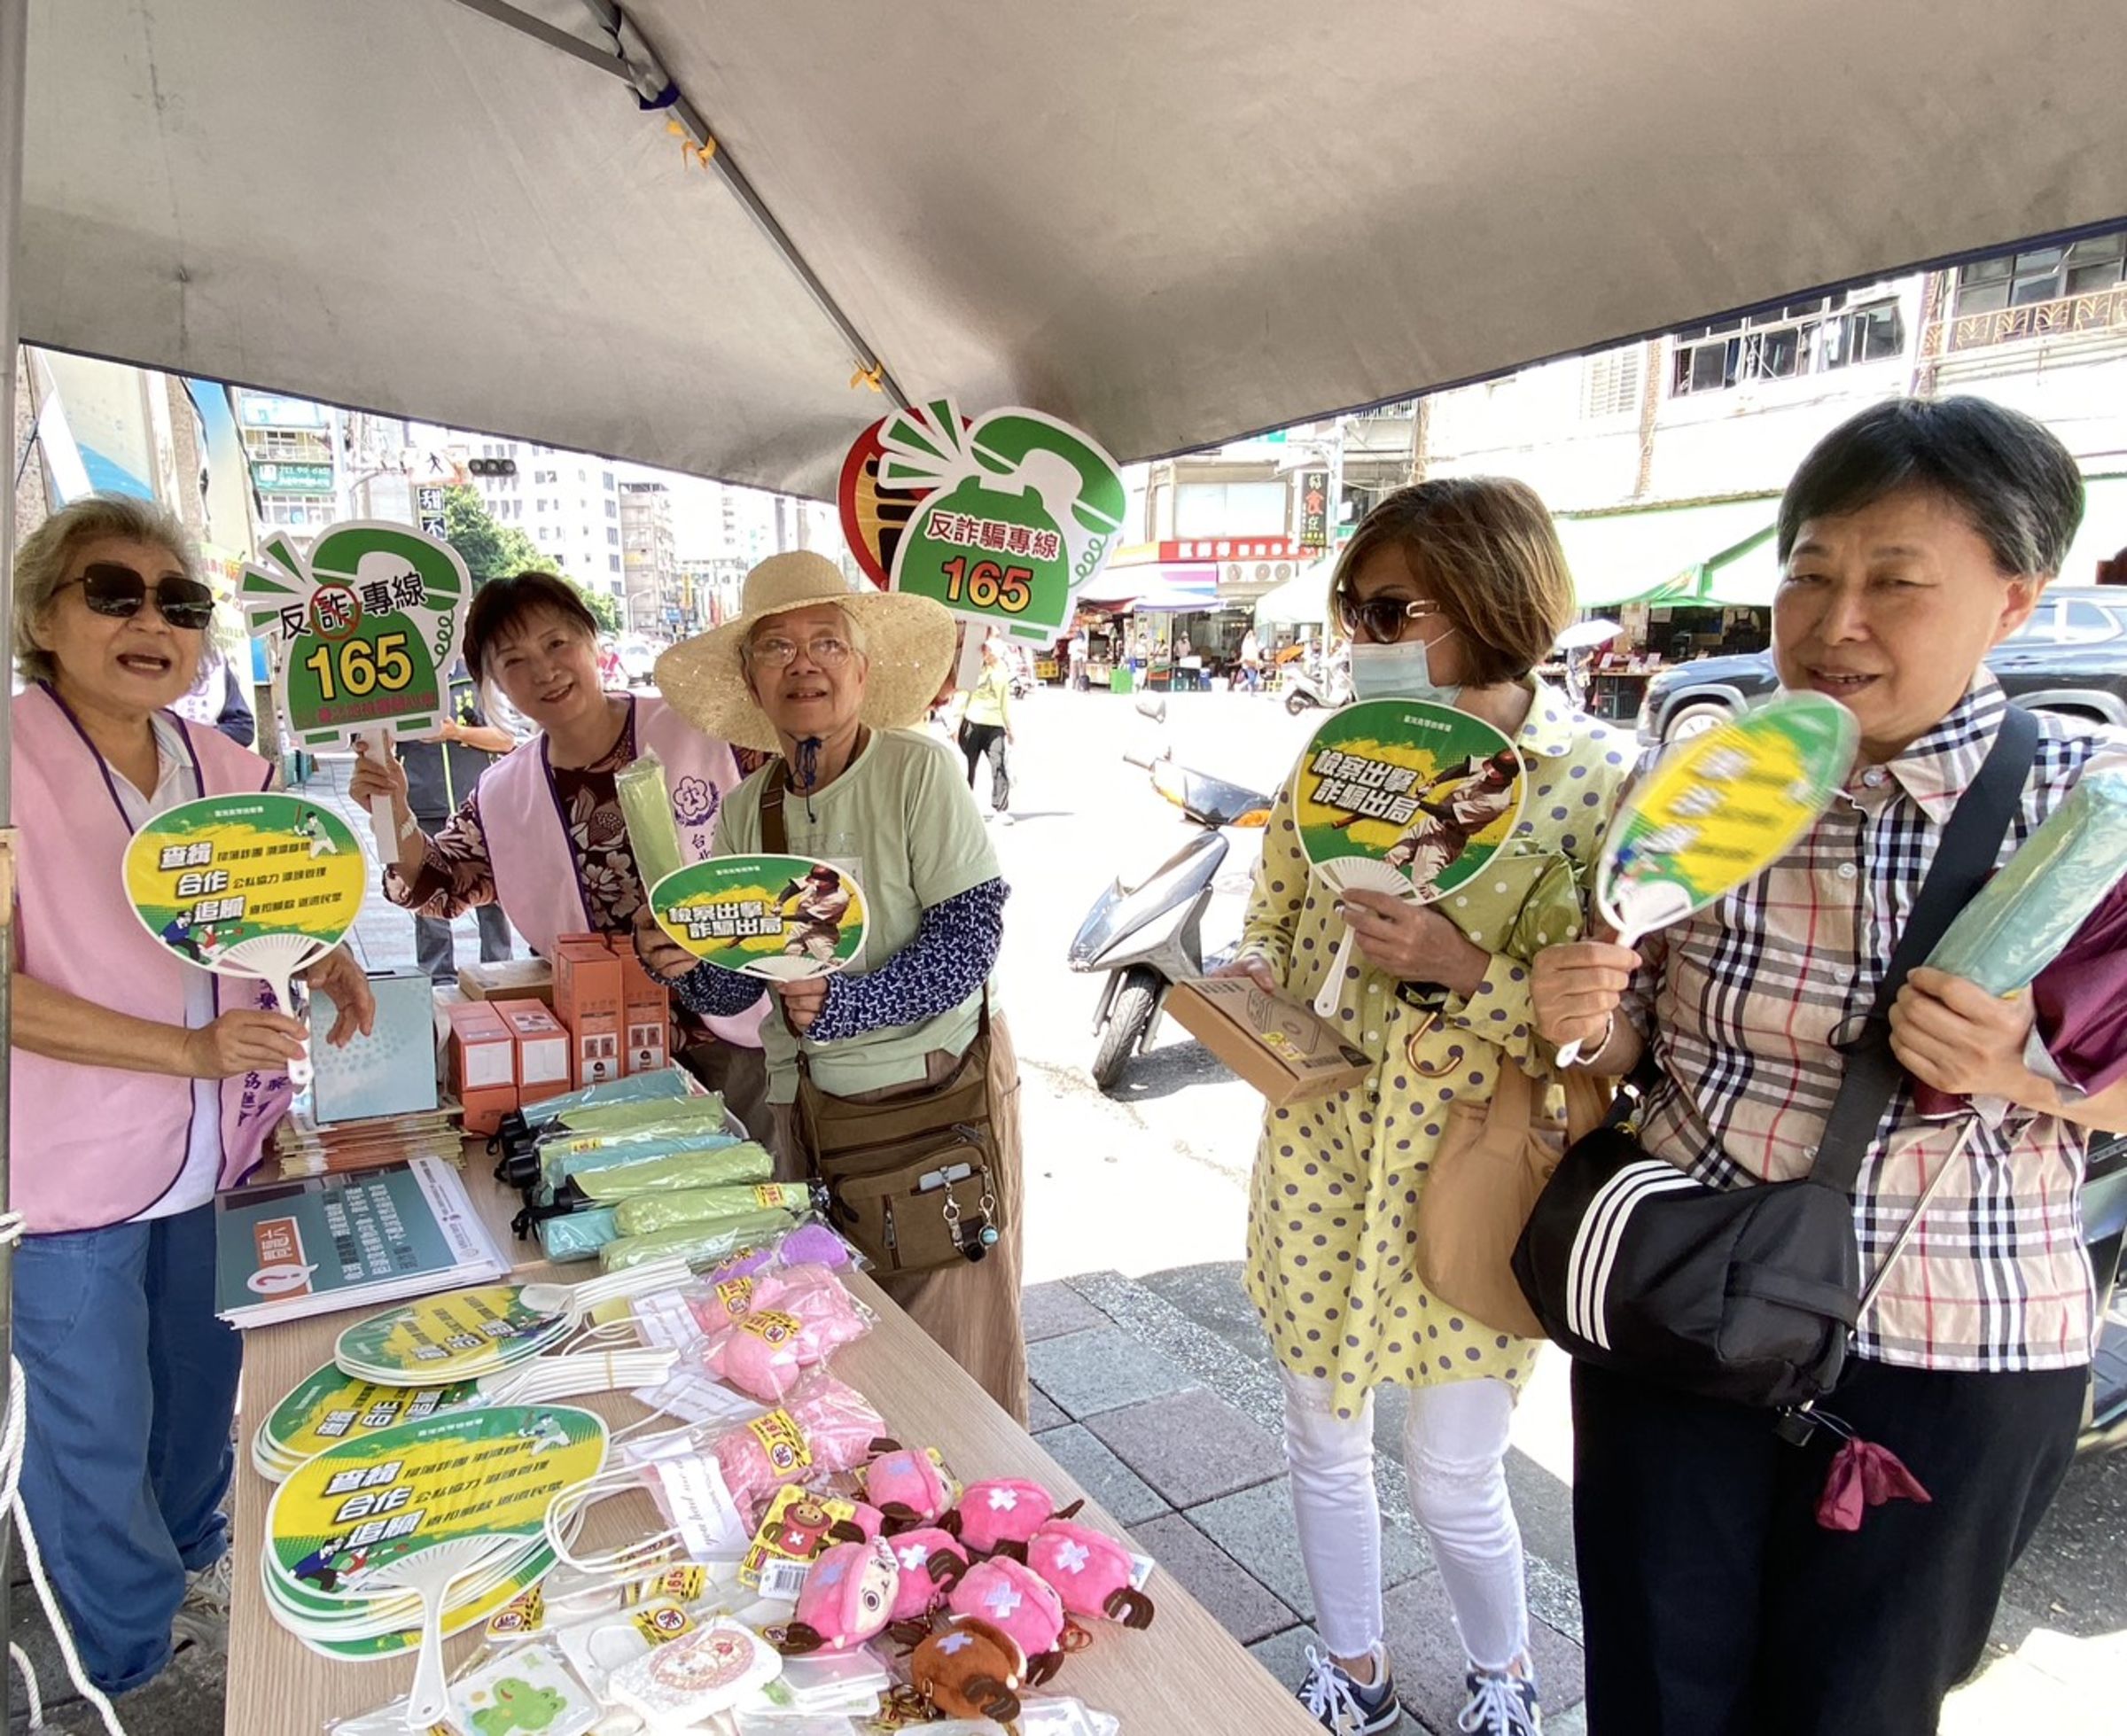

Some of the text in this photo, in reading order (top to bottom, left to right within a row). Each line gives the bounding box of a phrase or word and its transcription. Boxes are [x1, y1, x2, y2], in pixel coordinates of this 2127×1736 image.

[929, 512, 1059, 559] 反詐騙專線
[942, 556, 1032, 611] 165
[279, 572, 428, 640] 反詐專線
[307, 632, 413, 701] 165
[1313, 750, 1418, 793] 檢察出擊
[1313, 778, 1420, 825] 詐騙出局
[176, 870, 229, 898] 合作
[668, 901, 764, 924] 檢察出擊
[689, 916, 783, 939] 詐騙出局
[362, 1398, 403, 1428] 合作
[324, 1460, 404, 1497] 查緝
[335, 1486, 414, 1522] 合作
